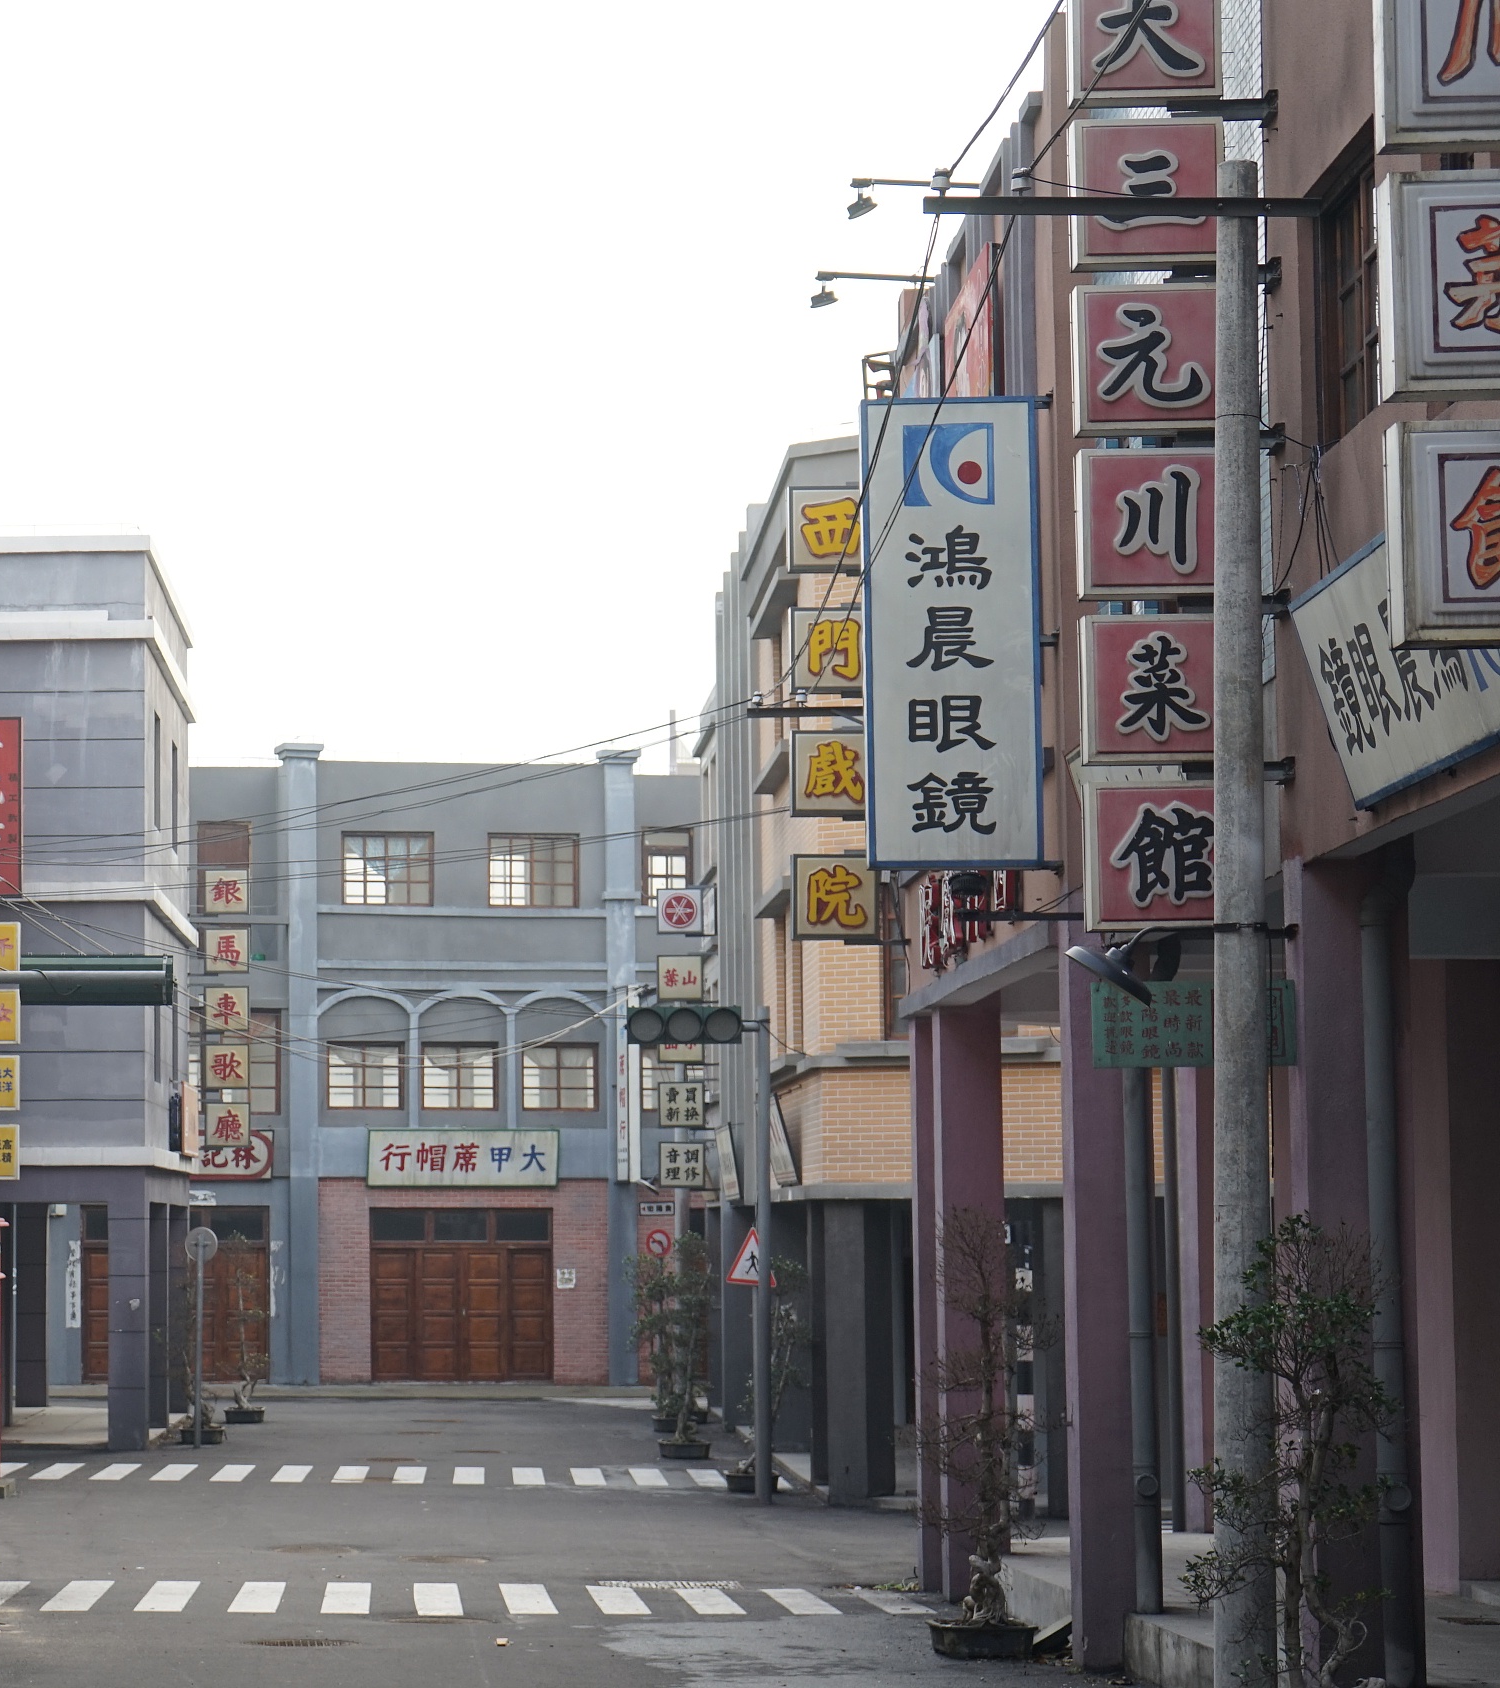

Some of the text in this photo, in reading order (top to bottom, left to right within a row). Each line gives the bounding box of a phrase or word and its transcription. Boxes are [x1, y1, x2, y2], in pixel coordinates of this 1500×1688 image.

[800, 497, 868, 930] 西門戲院
[905, 525, 997, 836] 鴻晨眼鏡
[210, 878, 243, 1143] 銀馬車歌廳
[664, 968, 698, 987] 山葉
